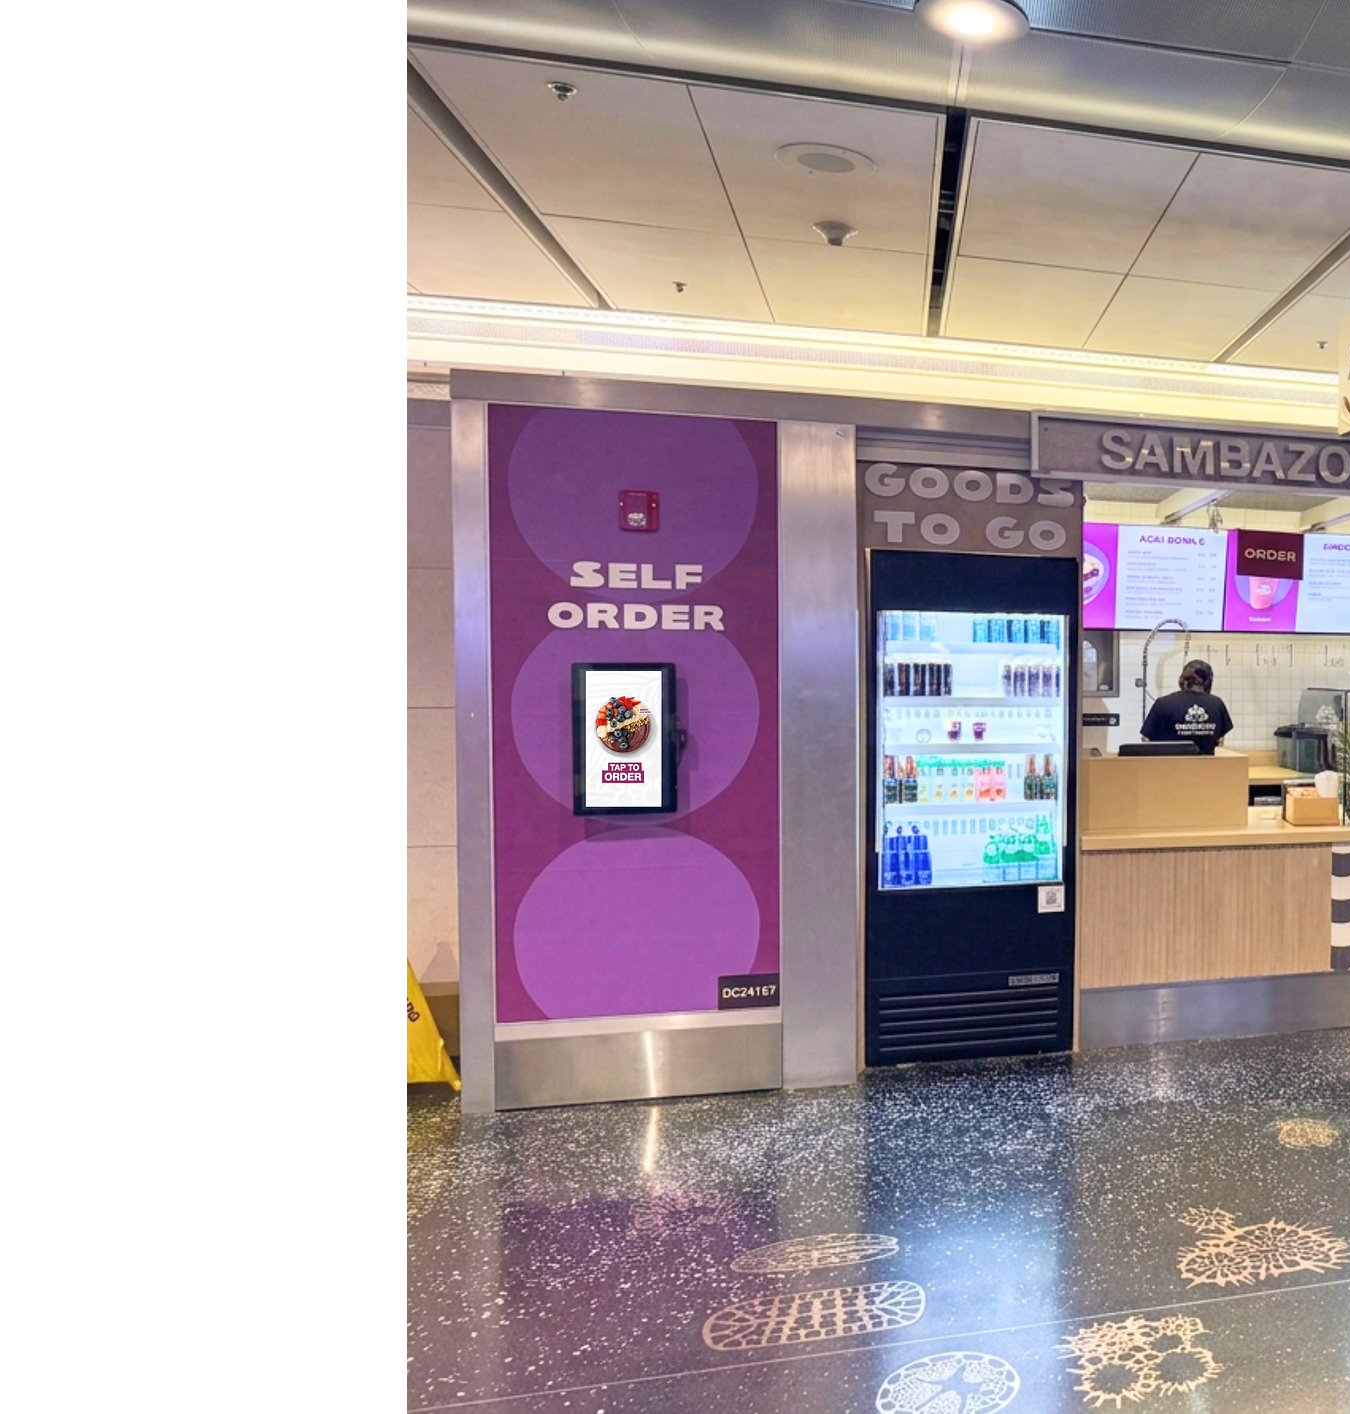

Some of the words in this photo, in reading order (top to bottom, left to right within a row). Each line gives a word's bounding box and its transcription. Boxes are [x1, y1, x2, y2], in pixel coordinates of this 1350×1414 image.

[864, 462, 1075, 508] GOODS
[873, 509, 961, 546] TO
[985, 516, 1067, 551] GO
[1244, 547, 1297, 563] ORDER
[569, 560, 703, 590] SELF
[547, 601, 725, 632] ORDER
[604, 771, 642, 782] ORDER
[609, 763, 626, 772] TAP
[627, 763, 640, 772] TO
[722, 985, 777, 999] DC24167
